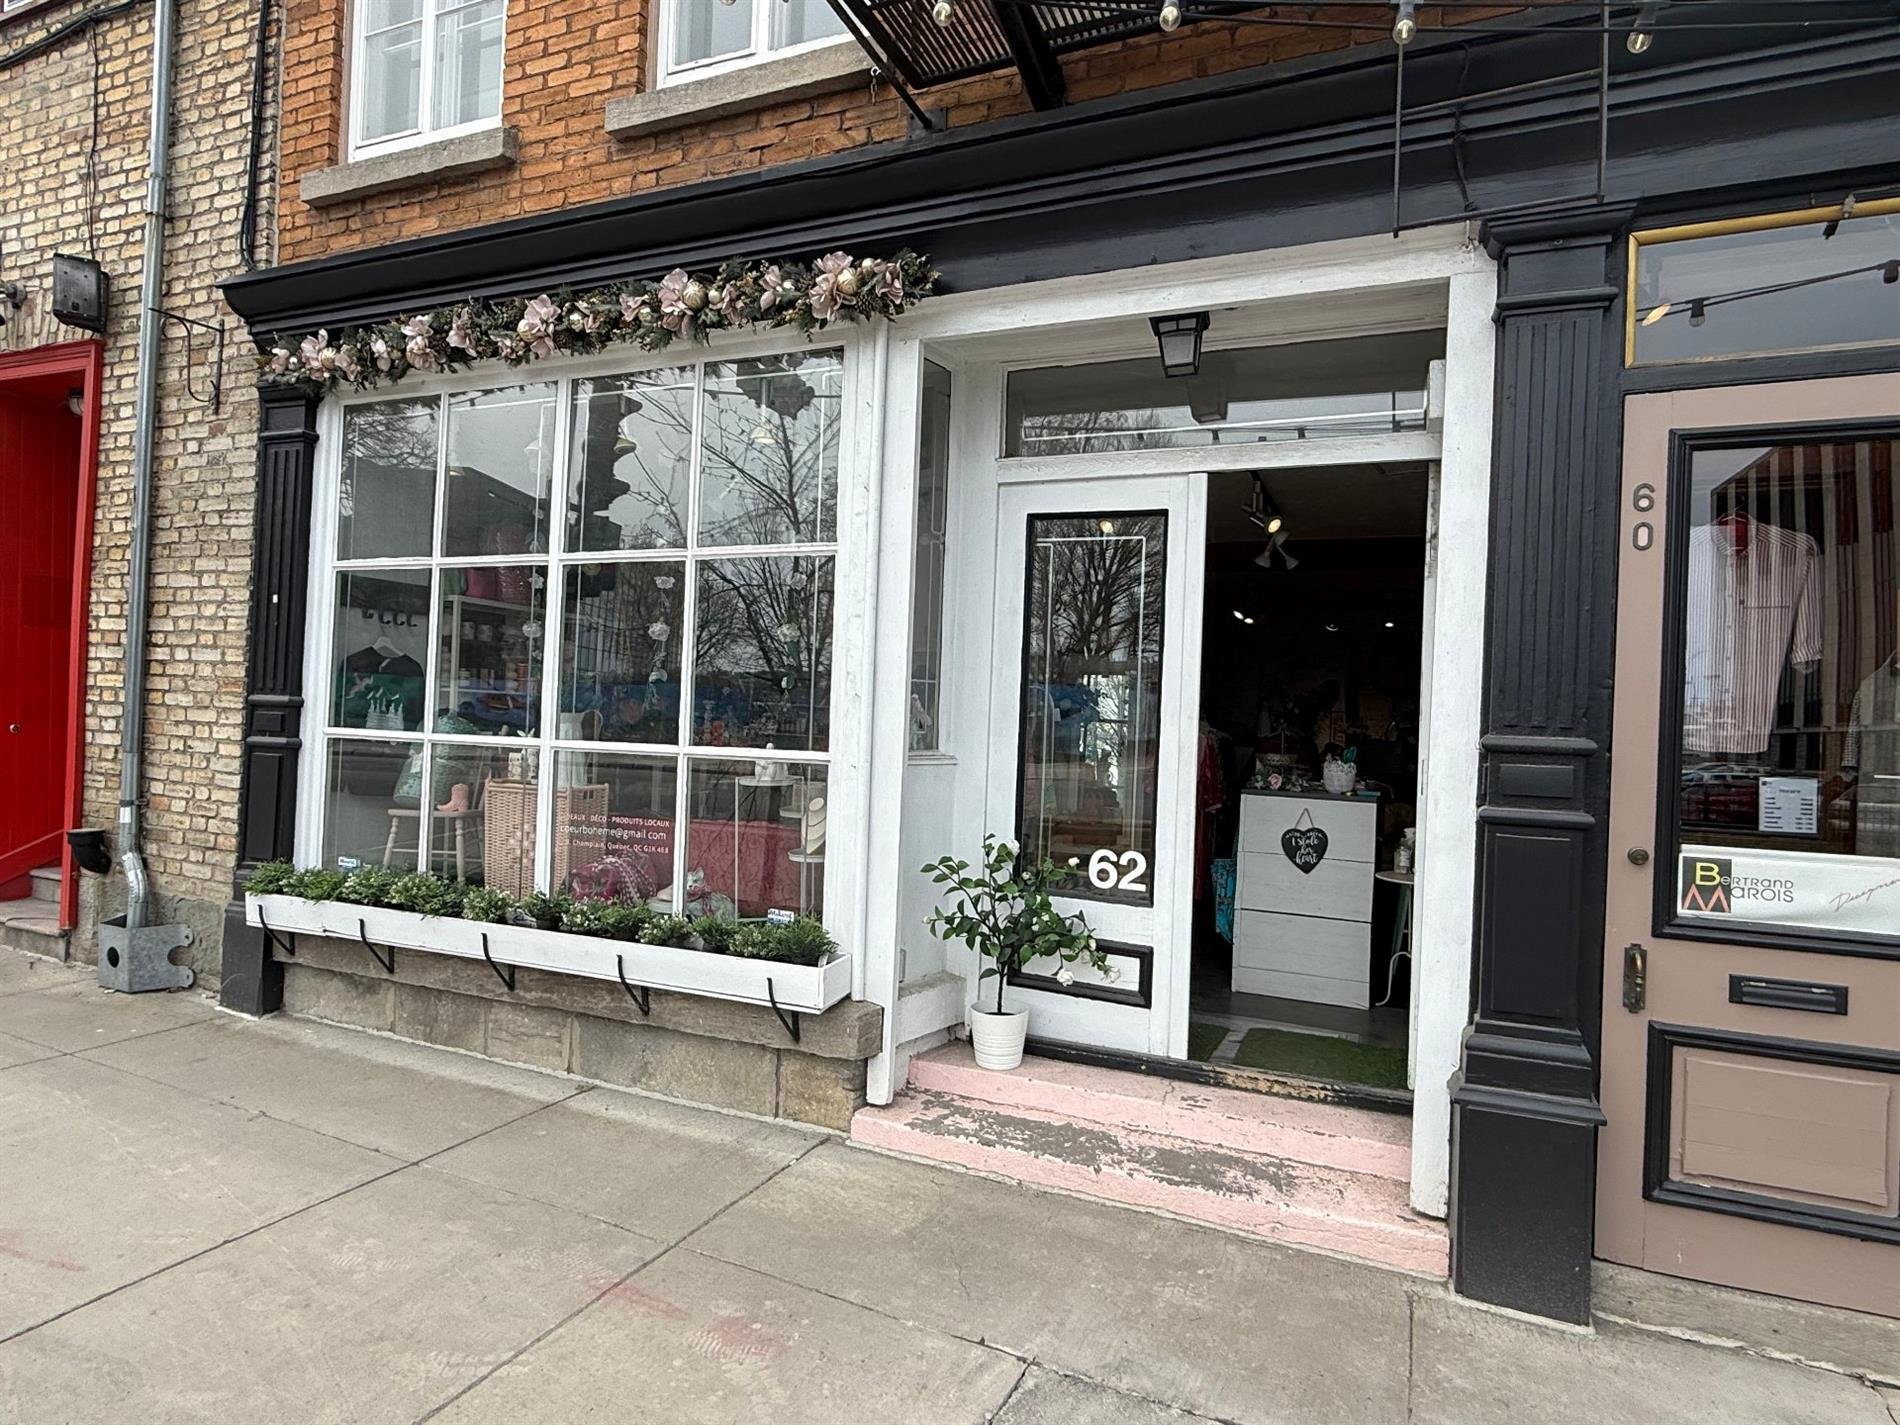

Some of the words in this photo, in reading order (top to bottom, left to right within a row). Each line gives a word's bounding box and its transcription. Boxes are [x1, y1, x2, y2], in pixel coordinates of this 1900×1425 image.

[1633, 483, 1655, 551] 60
[612, 816, 643, 826] PRODUITS
[644, 819, 670, 828] LOCAUX
[1088, 848, 1147, 892] 62
